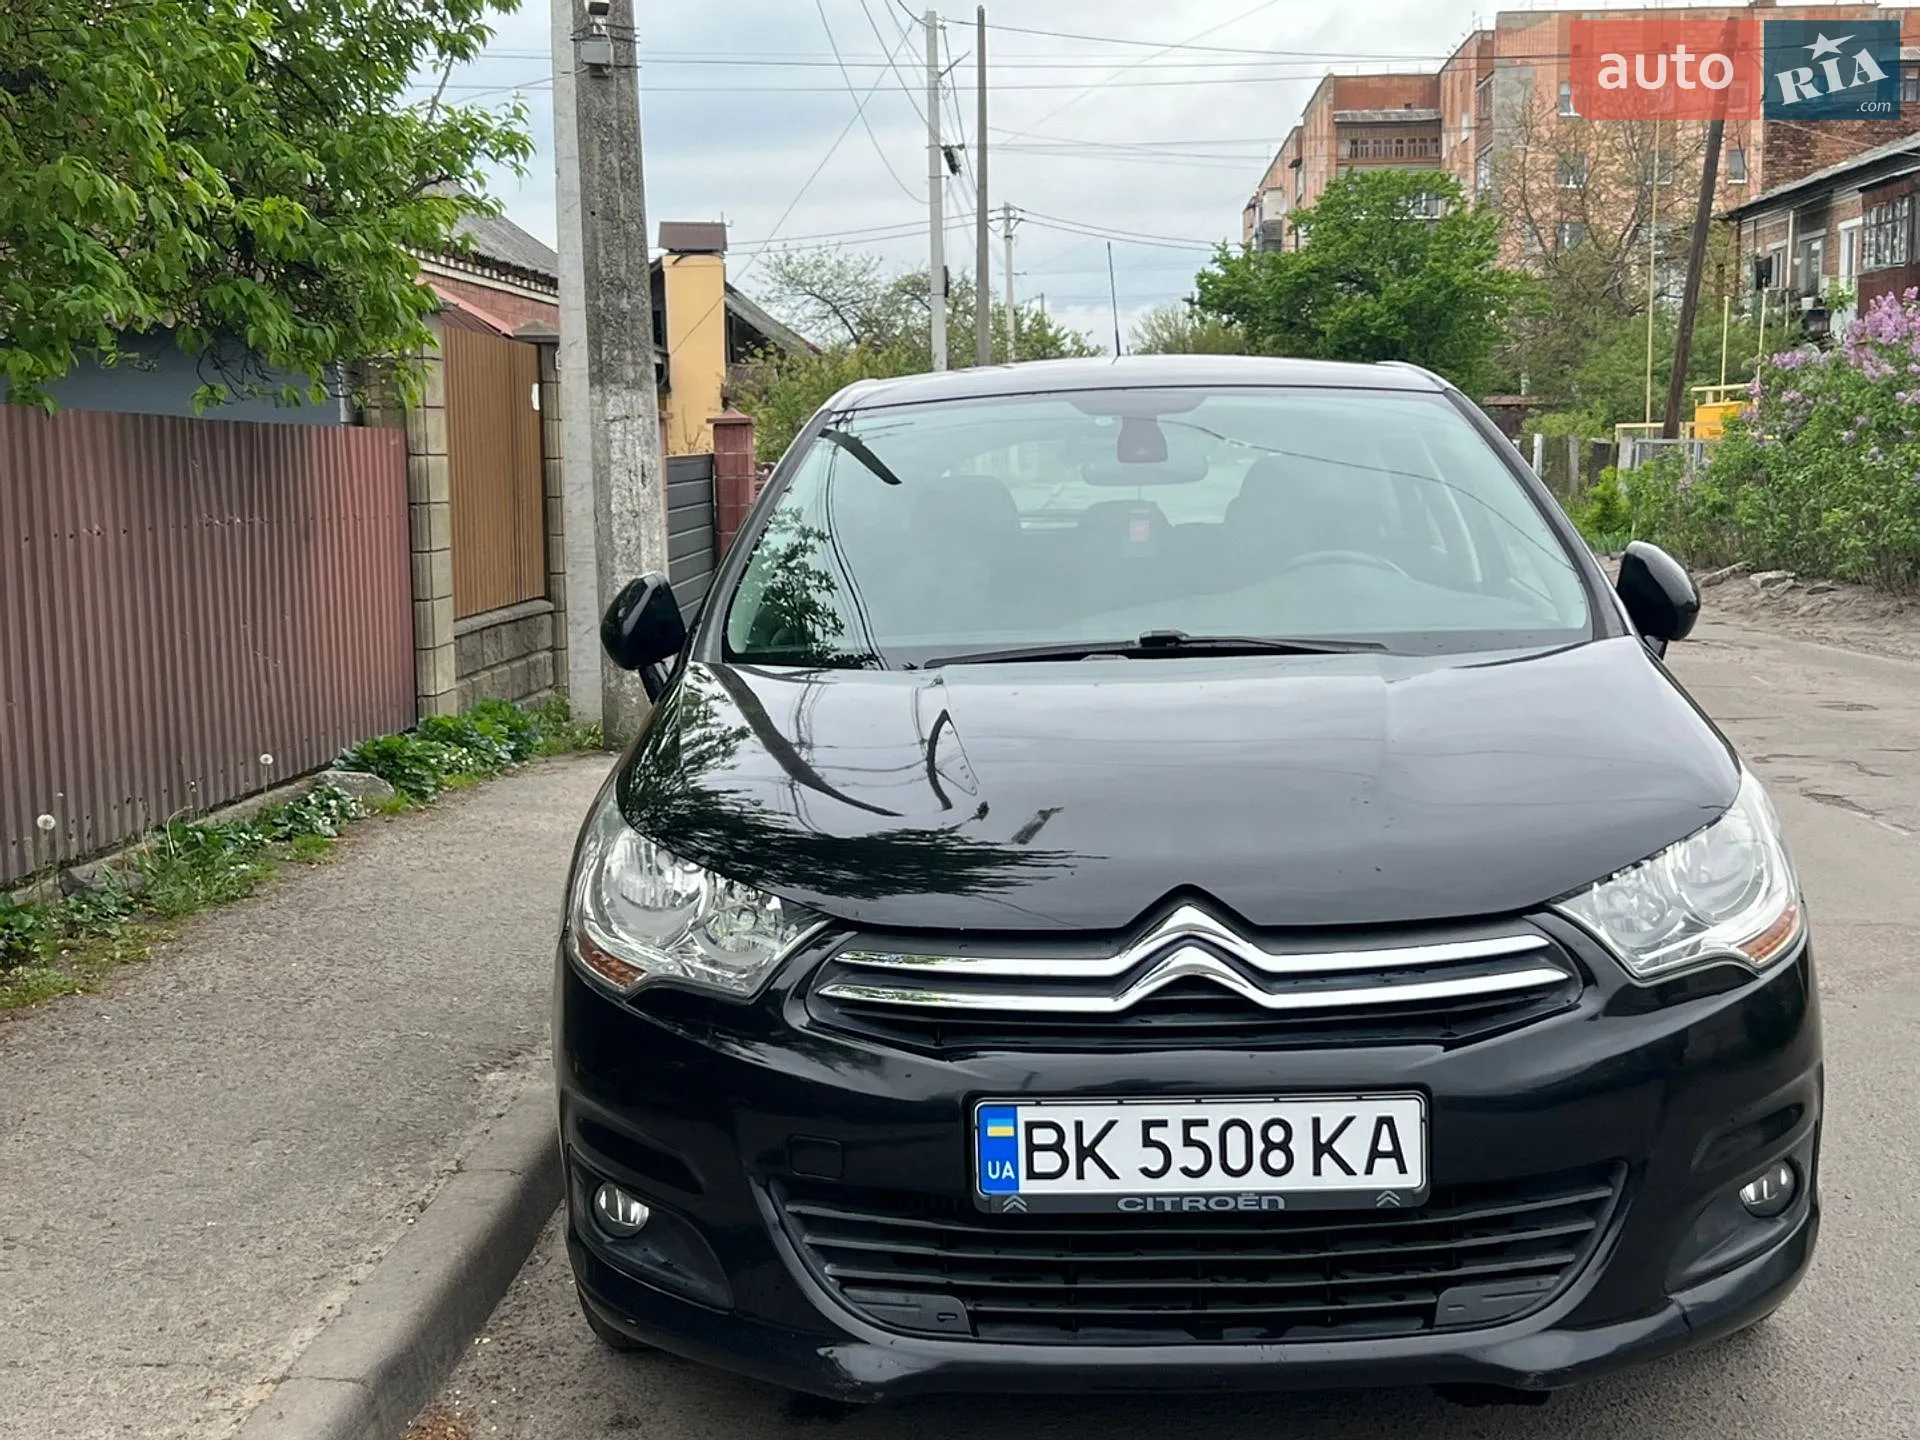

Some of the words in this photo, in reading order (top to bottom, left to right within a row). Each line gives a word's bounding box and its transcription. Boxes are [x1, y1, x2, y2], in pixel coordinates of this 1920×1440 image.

[1024, 1118, 1121, 1181] BK
[1138, 1117, 1295, 1180] 5508
[1311, 1115, 1408, 1177] KA
[987, 1160, 1016, 1180] UA
